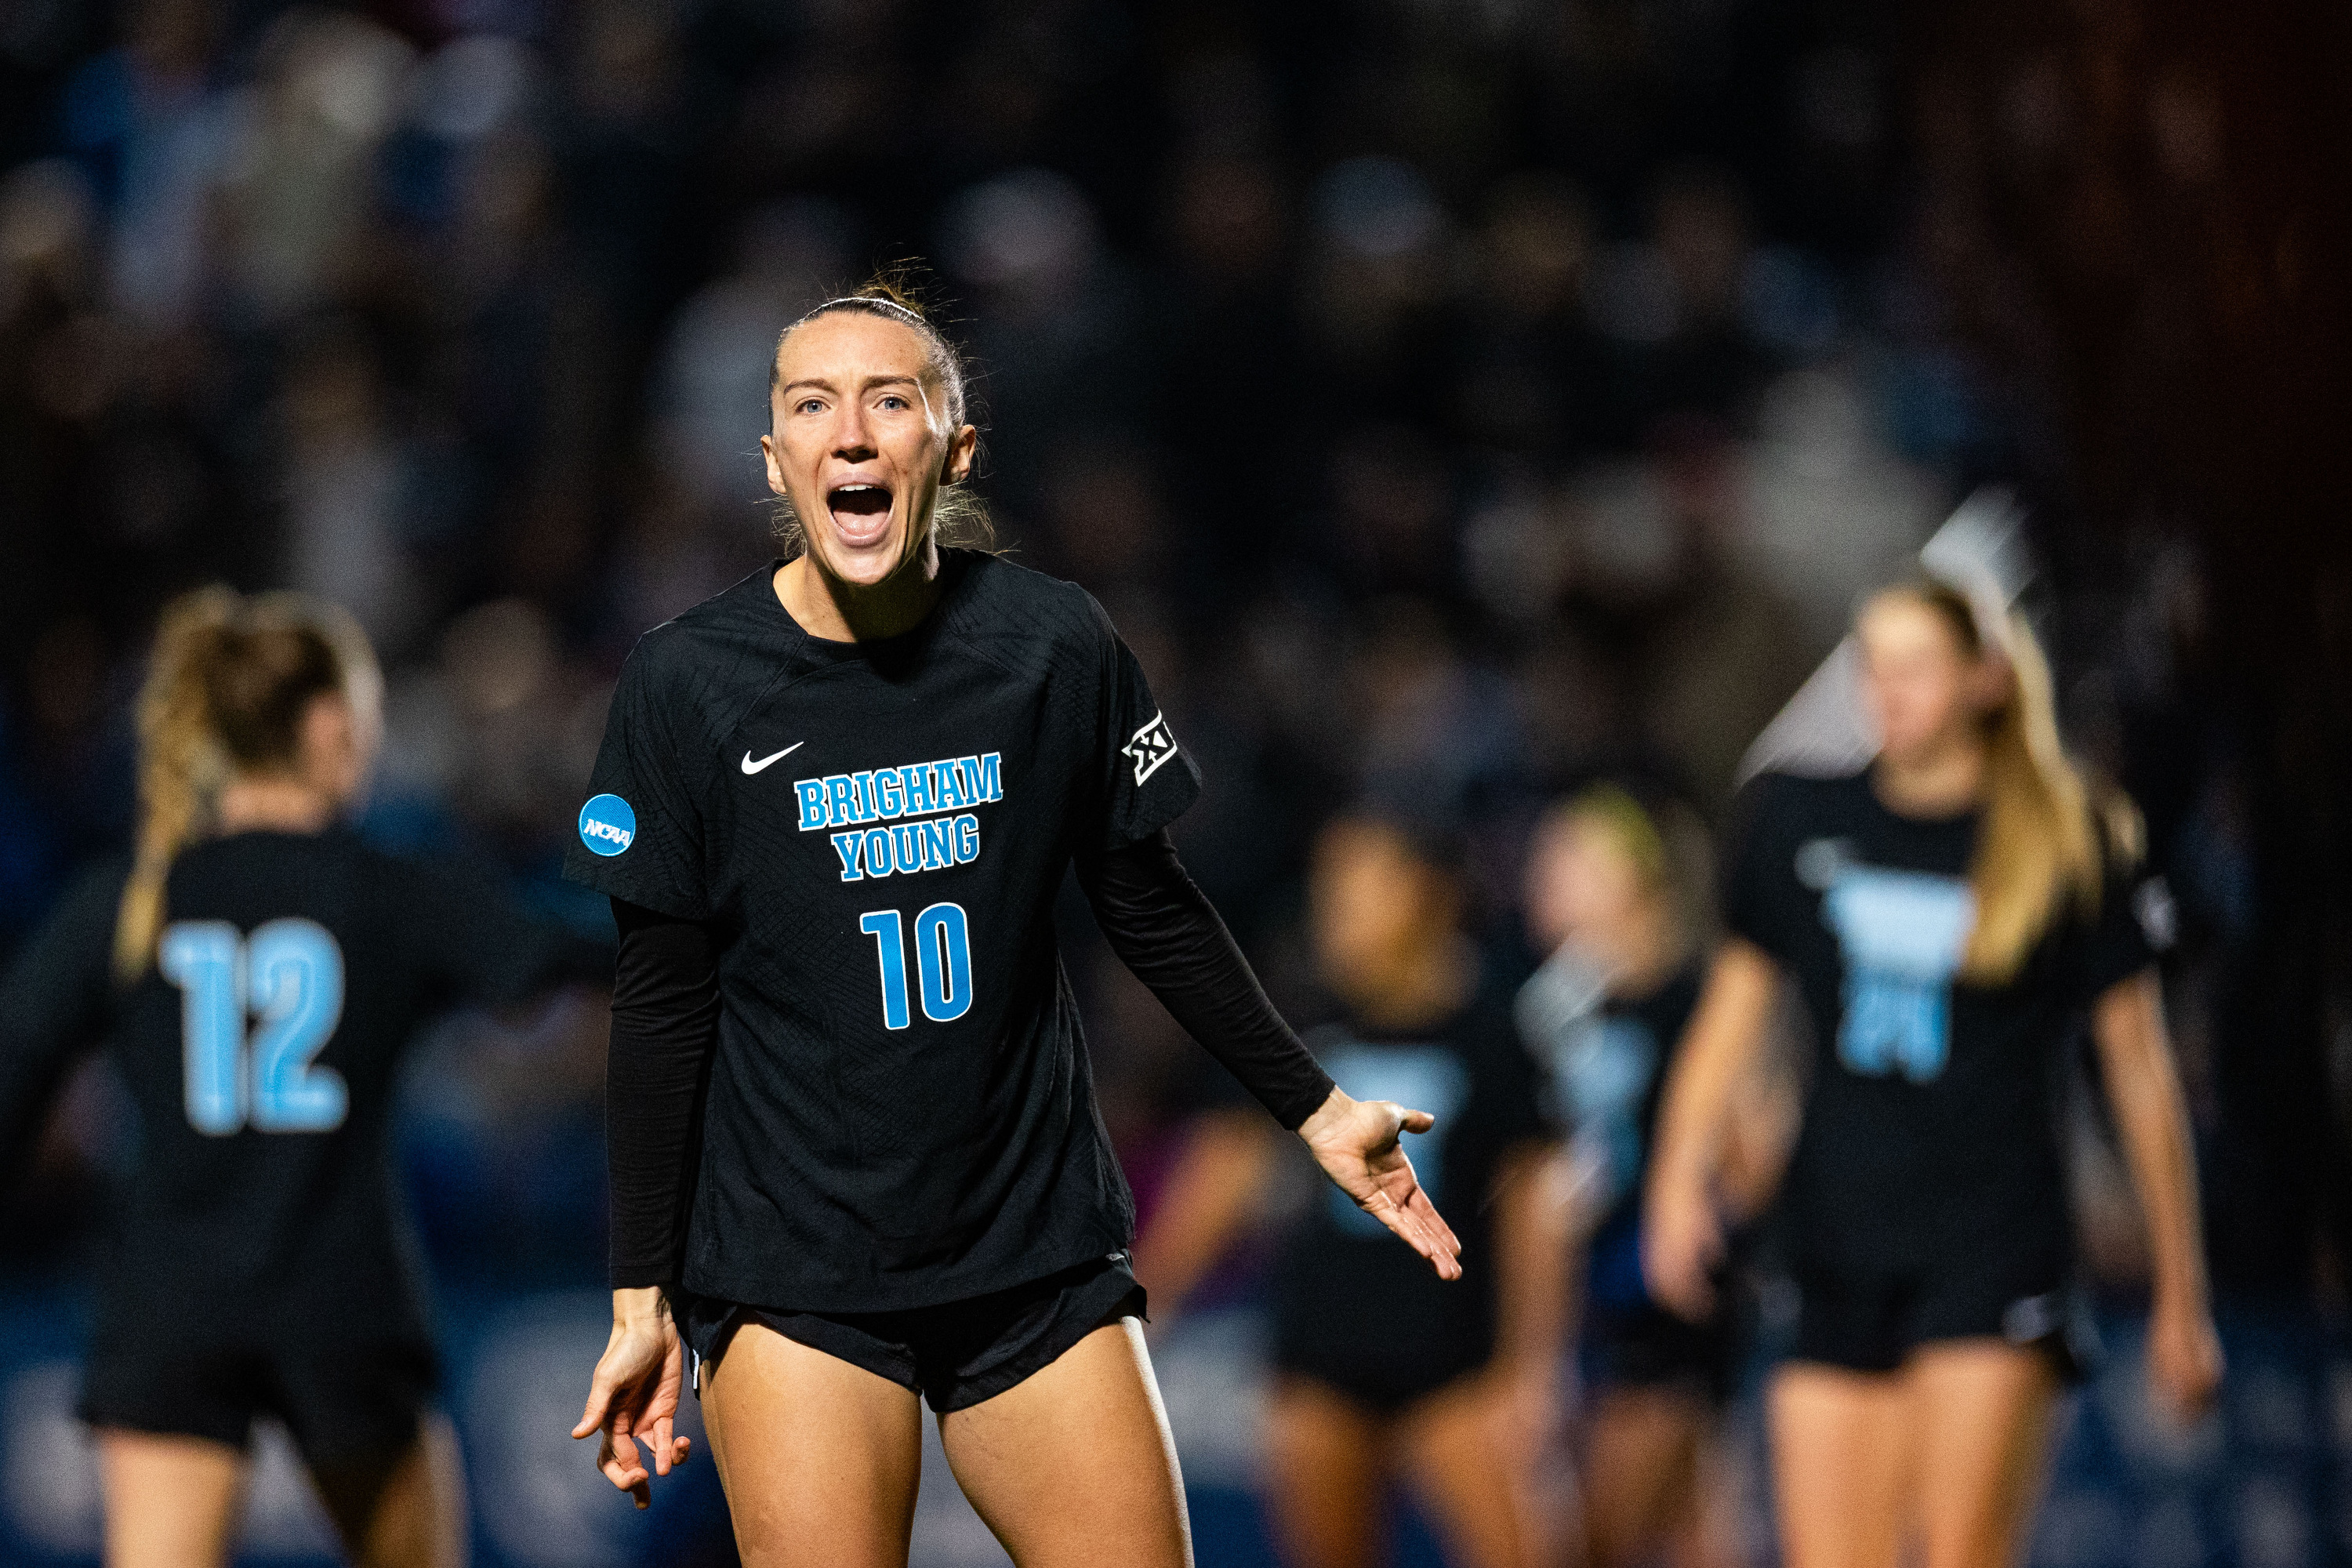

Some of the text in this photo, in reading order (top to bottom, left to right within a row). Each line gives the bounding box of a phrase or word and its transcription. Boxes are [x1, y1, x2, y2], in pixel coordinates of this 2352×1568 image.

[793, 751, 1004, 832] BRIGHAM
[583, 818, 630, 848] NCAA
[830, 813, 980, 882] YOUNG
[859, 902, 974, 1031] 10
[158, 916, 350, 1137] 12
